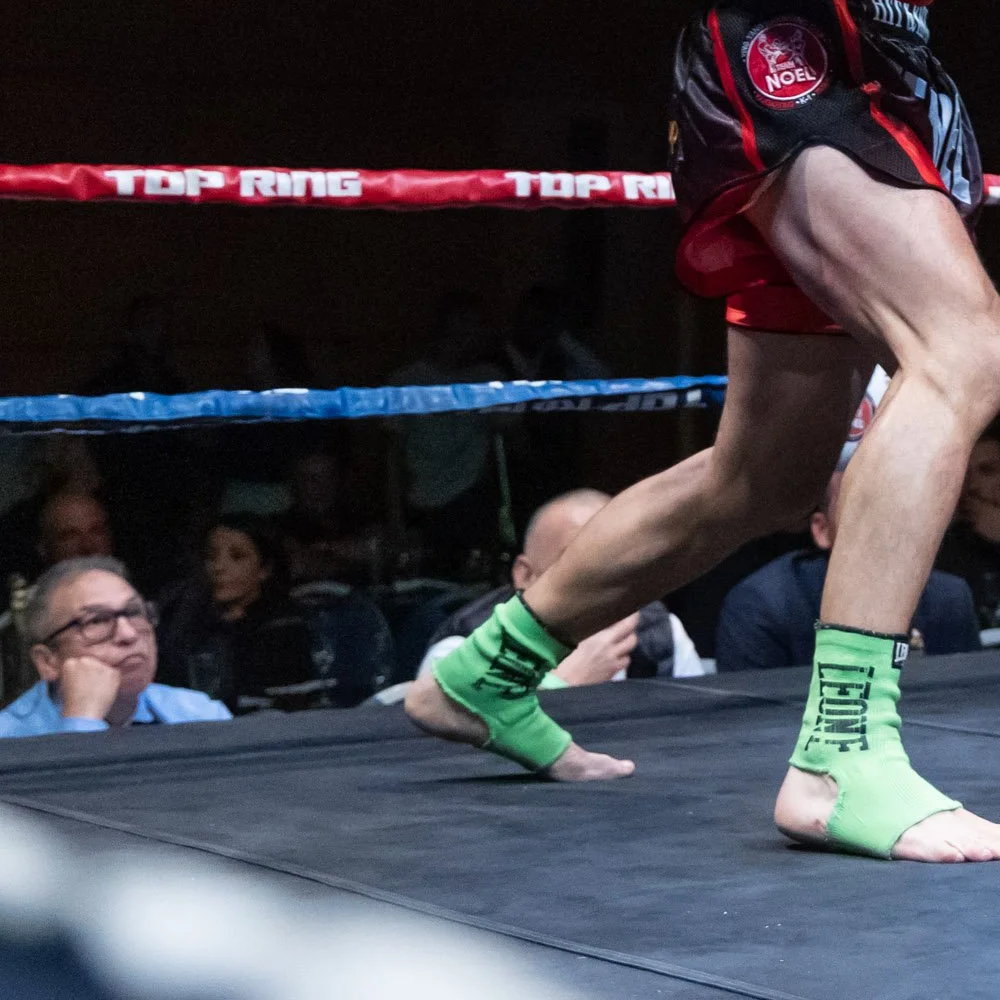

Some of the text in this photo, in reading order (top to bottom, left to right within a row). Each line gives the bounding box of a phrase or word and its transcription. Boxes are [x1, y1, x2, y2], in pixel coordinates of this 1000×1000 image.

[764, 65, 817, 94] NOEL
[103, 168, 363, 198] TOP RING
[504, 171, 612, 198] TOP
[804, 661, 875, 753] LEONE
